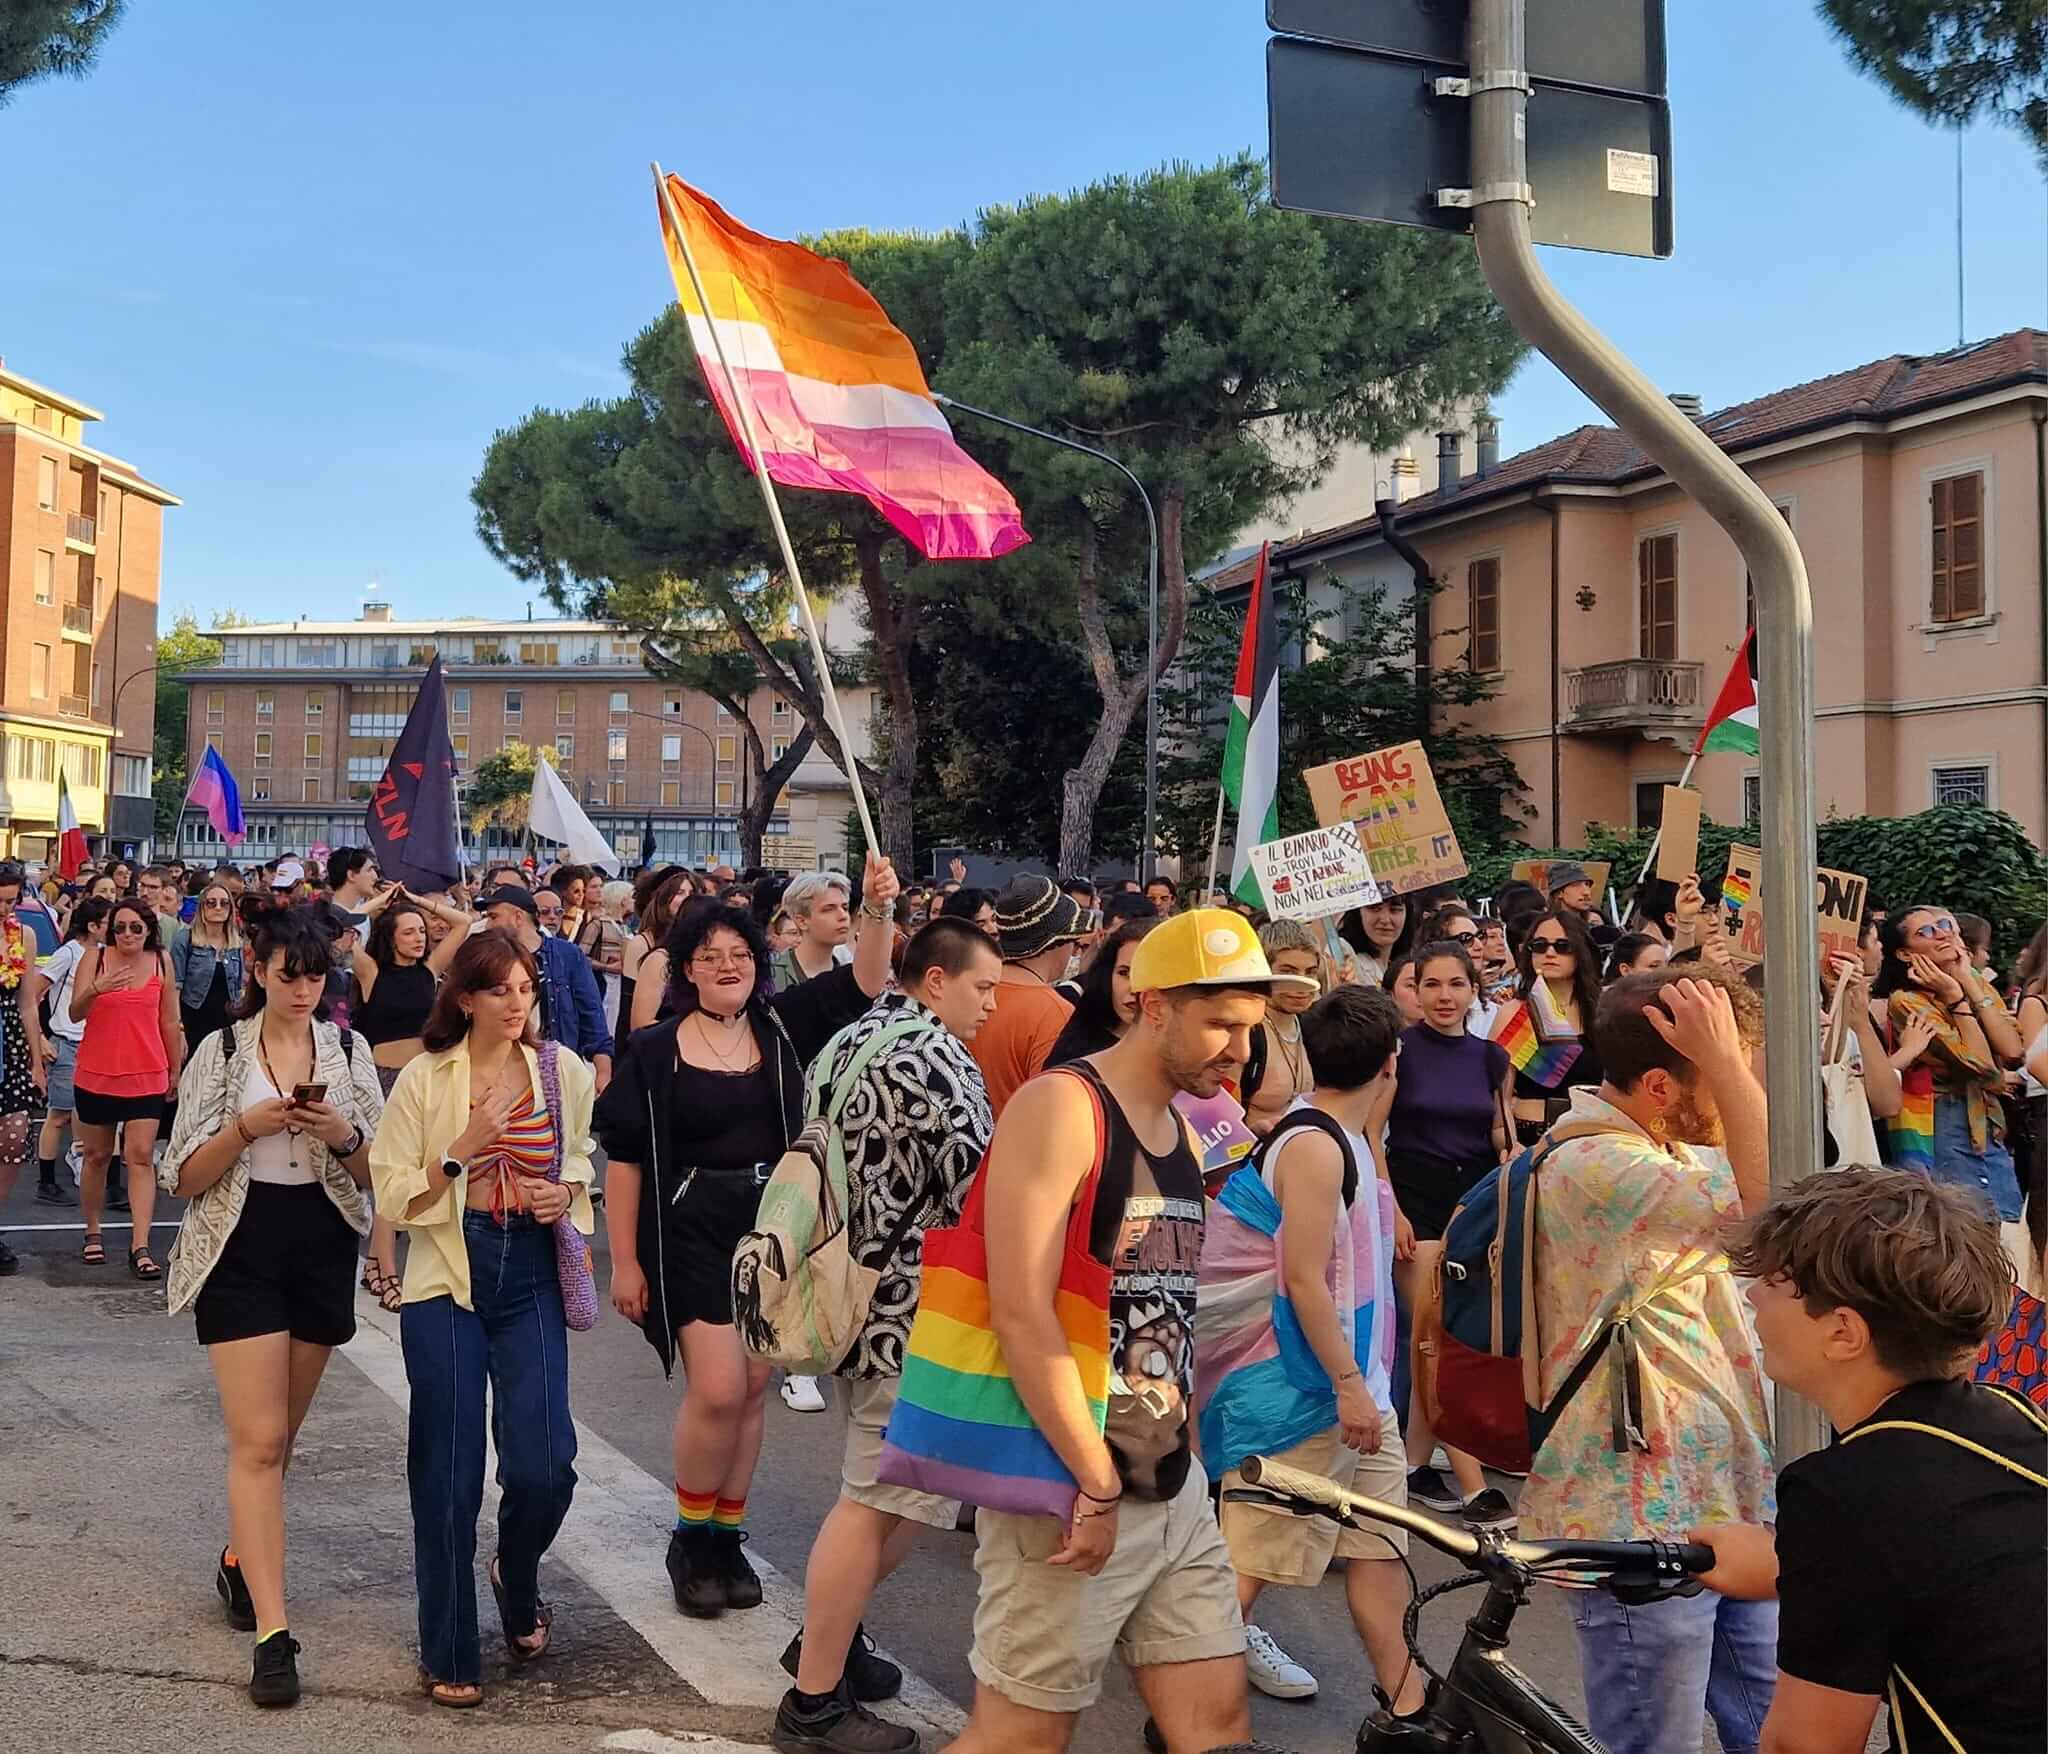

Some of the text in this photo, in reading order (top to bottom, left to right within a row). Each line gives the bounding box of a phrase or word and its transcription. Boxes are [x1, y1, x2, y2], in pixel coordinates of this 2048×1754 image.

[1334, 749, 1412, 791] BEING
[1340, 778, 1417, 829] GAY
[1268, 833, 1329, 862] IL BINARIO
[1363, 820, 1409, 850] LIKE
[1285, 855, 1315, 873] TROVI
[1321, 848, 1346, 863] ALLA
[1274, 893, 1301, 911] NON
